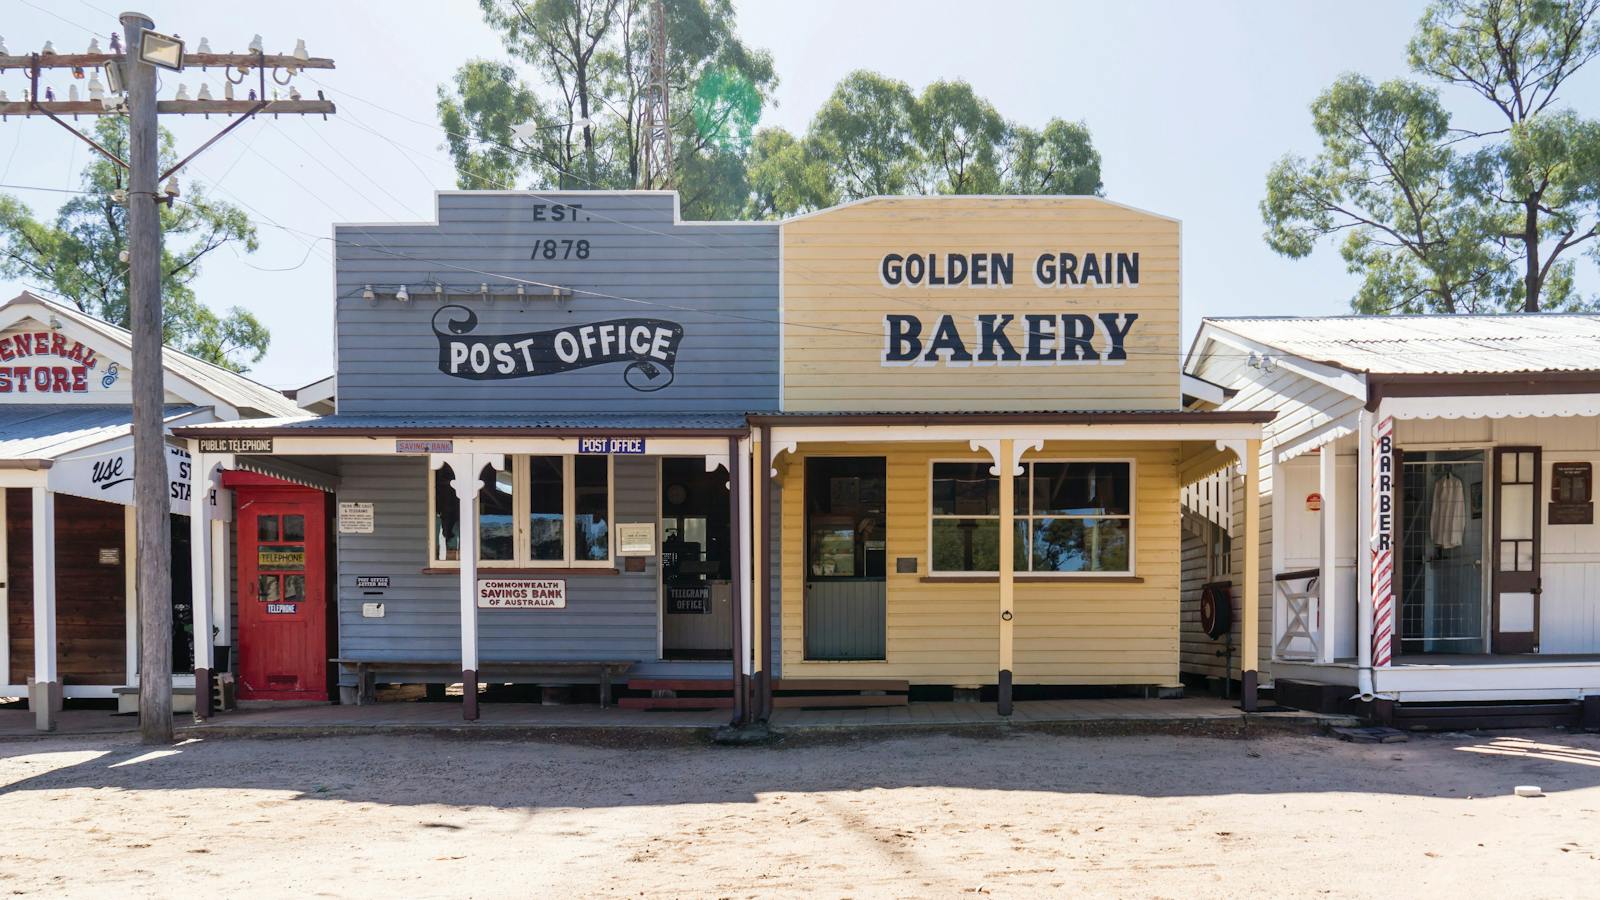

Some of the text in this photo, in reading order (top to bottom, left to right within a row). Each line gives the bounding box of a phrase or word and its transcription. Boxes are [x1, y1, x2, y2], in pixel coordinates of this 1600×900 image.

[532, 204, 592, 222] EST.
[531, 239, 591, 260] 1878
[879, 252, 1140, 288] GOLDEN GRAIN
[881, 312, 1139, 367] BAKERY
[0, 332, 97, 370] ENERAL
[449, 324, 674, 375] POST OFFICE
[0, 366, 89, 394] STORE
[200, 440, 271, 452] PUBLIC TELEPHONE
[432, 441, 451, 450] BANK
[582, 439, 642, 452] POST OFFICE
[92, 456, 124, 483] use
[1379, 436, 1392, 551] BARBER
[260, 553, 304, 562] TELEPHONE
[481, 589, 563, 598] SAVINGS BANK
[671, 588, 709, 598] TELEGRAPH
[267, 604, 296, 613] TELEPHONE
[676, 600, 703, 609] OFFICE
